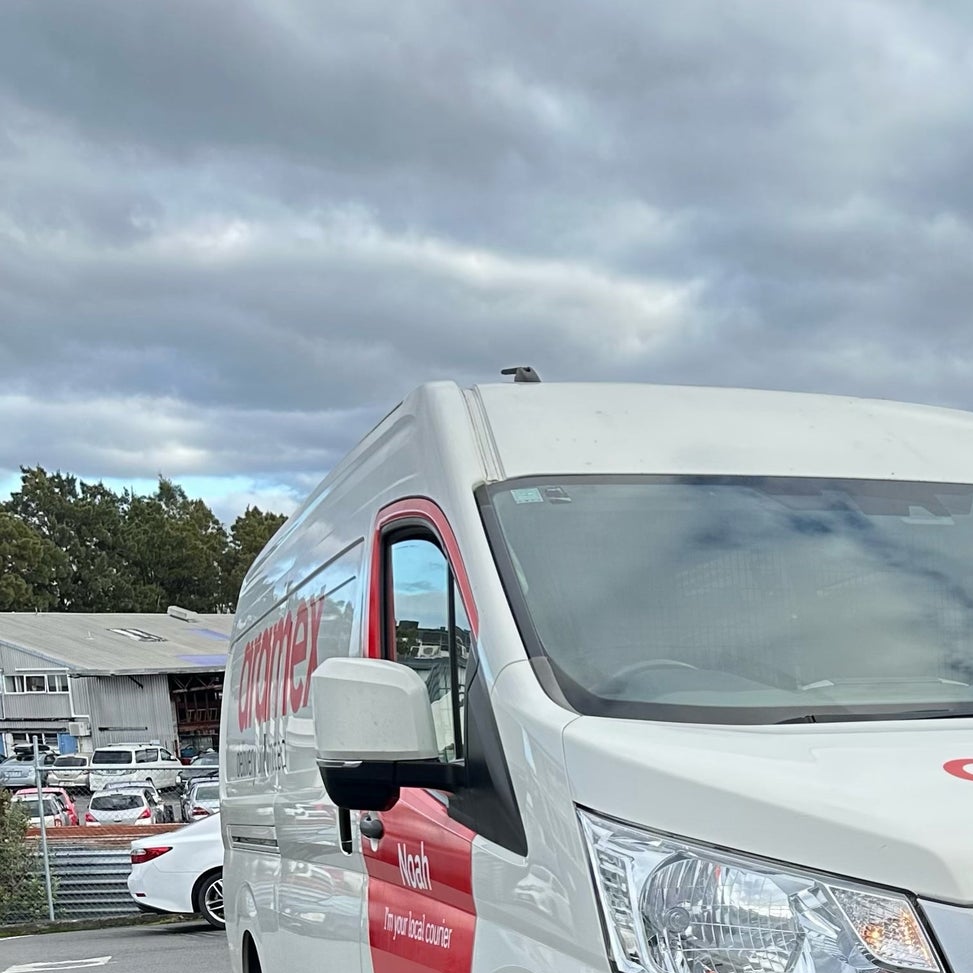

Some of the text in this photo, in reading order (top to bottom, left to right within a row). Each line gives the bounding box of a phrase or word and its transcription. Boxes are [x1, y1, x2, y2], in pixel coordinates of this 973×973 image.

[238, 584, 327, 733] aramex
[397, 841, 432, 890] Noah
[392, 914, 409, 940] your
[408, 911, 425, 941] local
[425, 919, 452, 948] courier
